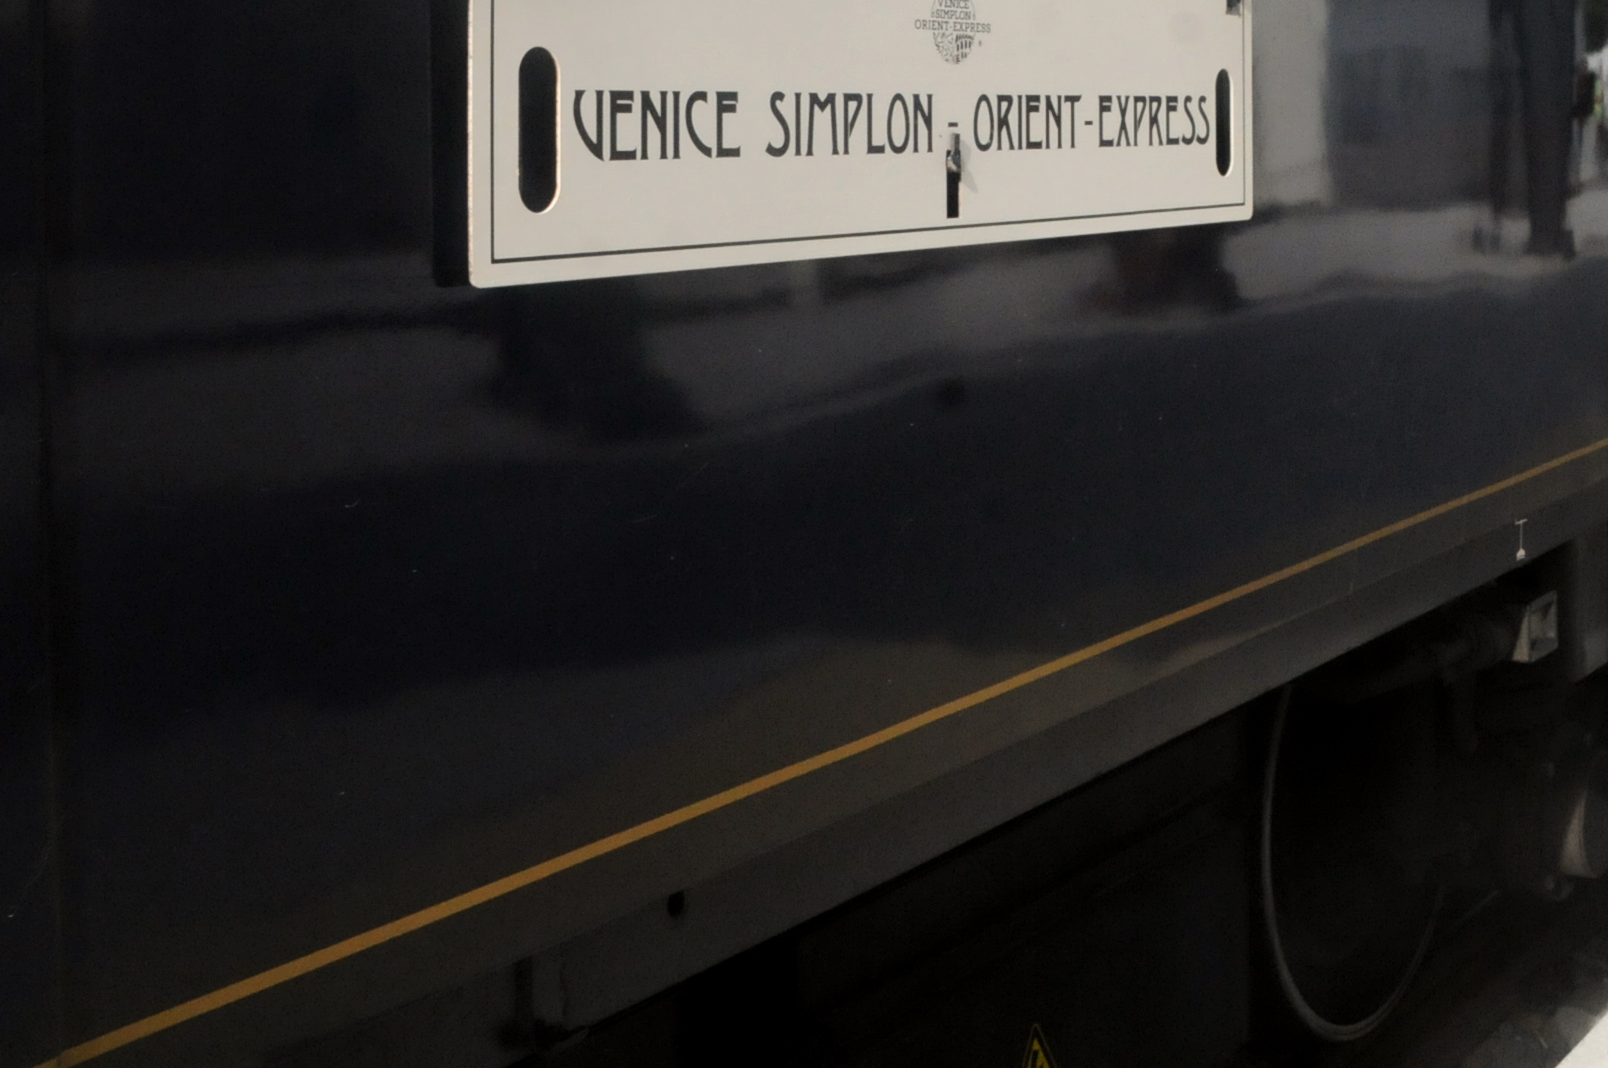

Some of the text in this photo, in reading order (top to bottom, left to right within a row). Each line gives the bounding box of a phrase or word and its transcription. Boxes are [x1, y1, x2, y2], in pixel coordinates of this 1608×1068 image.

[935, 9, 972, 21] SIMPLON
[914, 19, 992, 34] ORIENT-EXPRESS
[573, 90, 741, 162] VENICE
[765, 91, 934, 158] SIMPLON
[973, 93, 1211, 152] ORIENT-EXPRESS
